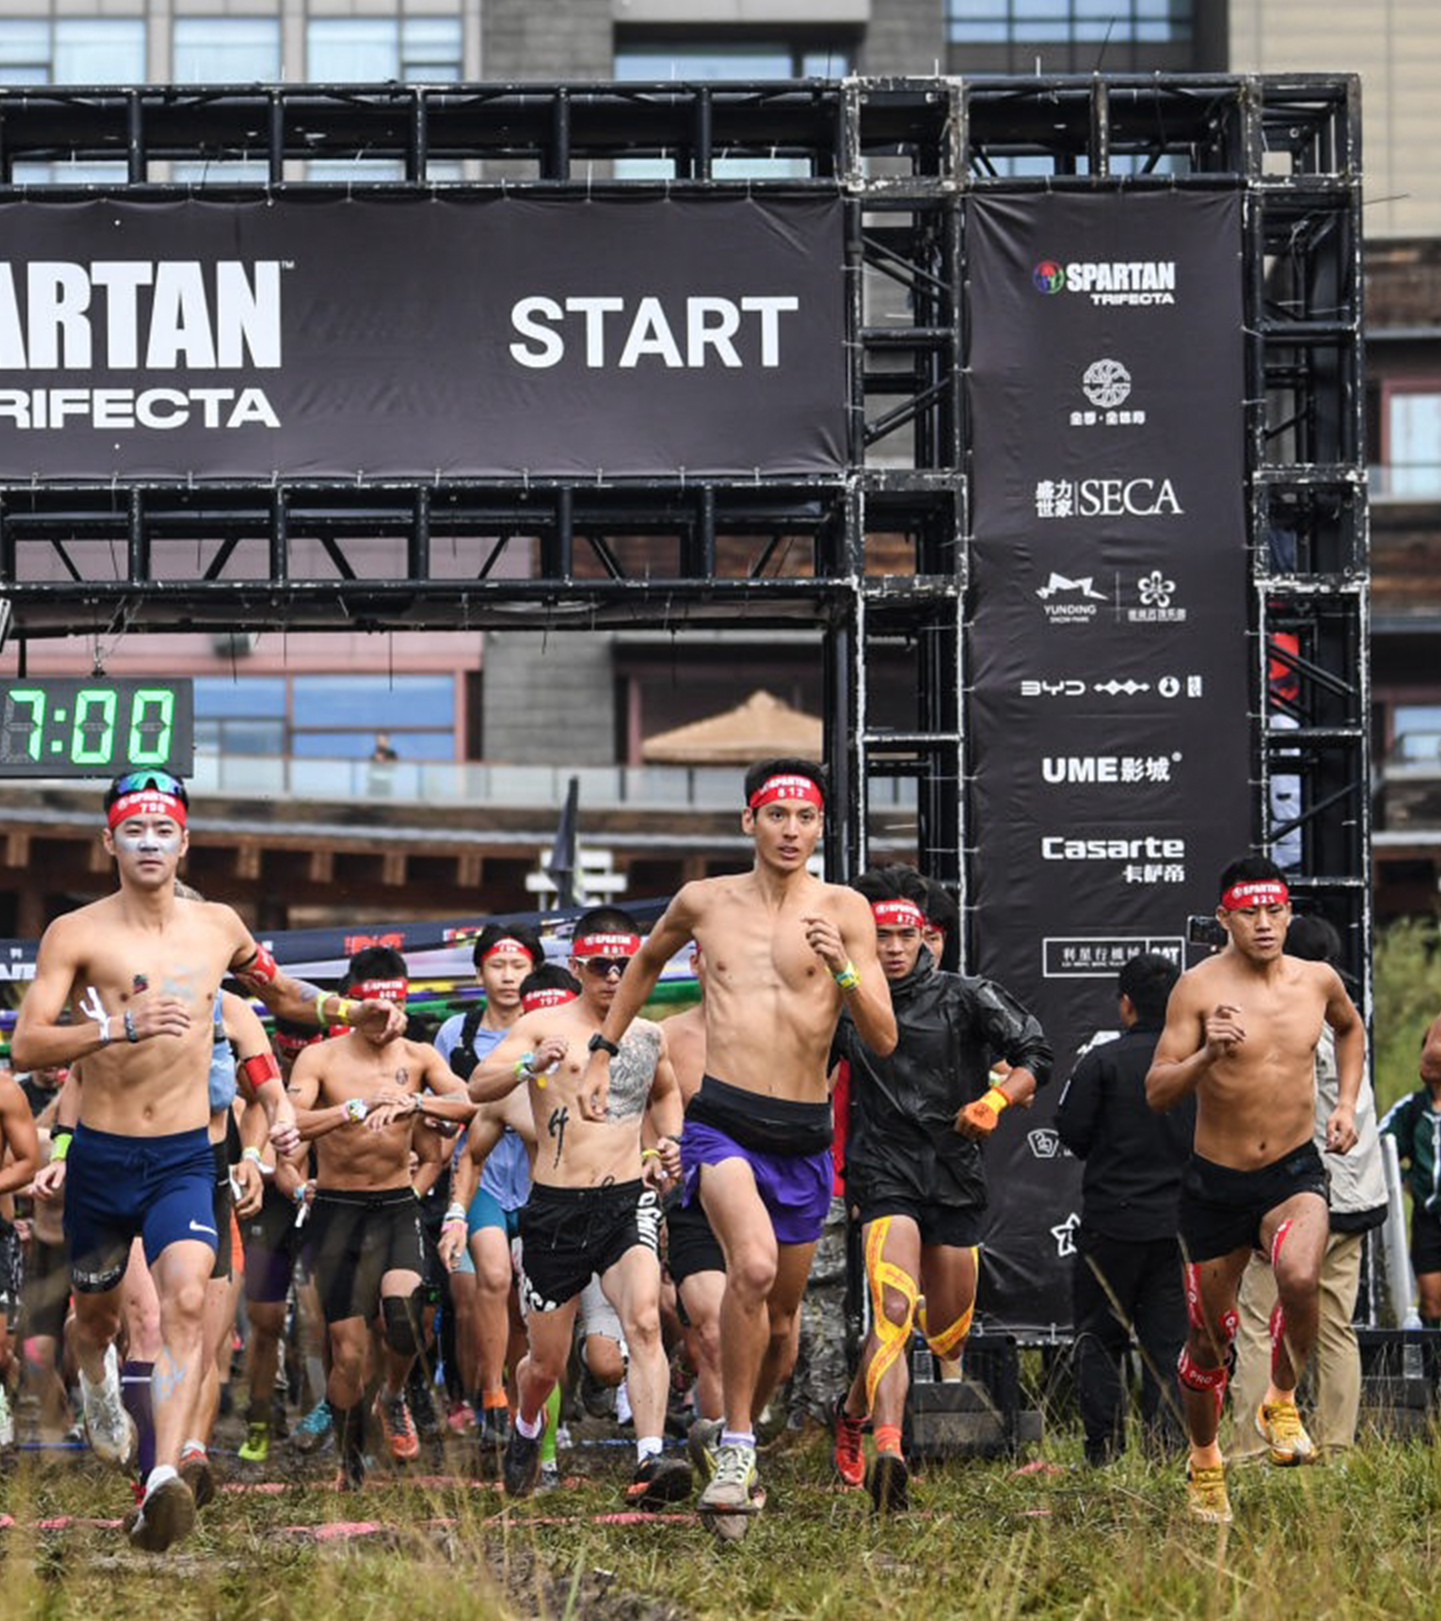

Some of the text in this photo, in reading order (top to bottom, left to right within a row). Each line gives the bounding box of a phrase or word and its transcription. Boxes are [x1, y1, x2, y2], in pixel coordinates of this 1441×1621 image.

[1065, 261, 1176, 292] SPARTAN
[1089, 293, 1175, 306] TRIFECTA
[509, 295, 799, 369] START
[1079, 478, 1185, 517] SECA
[1043, 604, 1097, 616] YUNDING
[1020, 680, 1086, 696] BYD
[1041, 836, 1185, 860] Casarte
